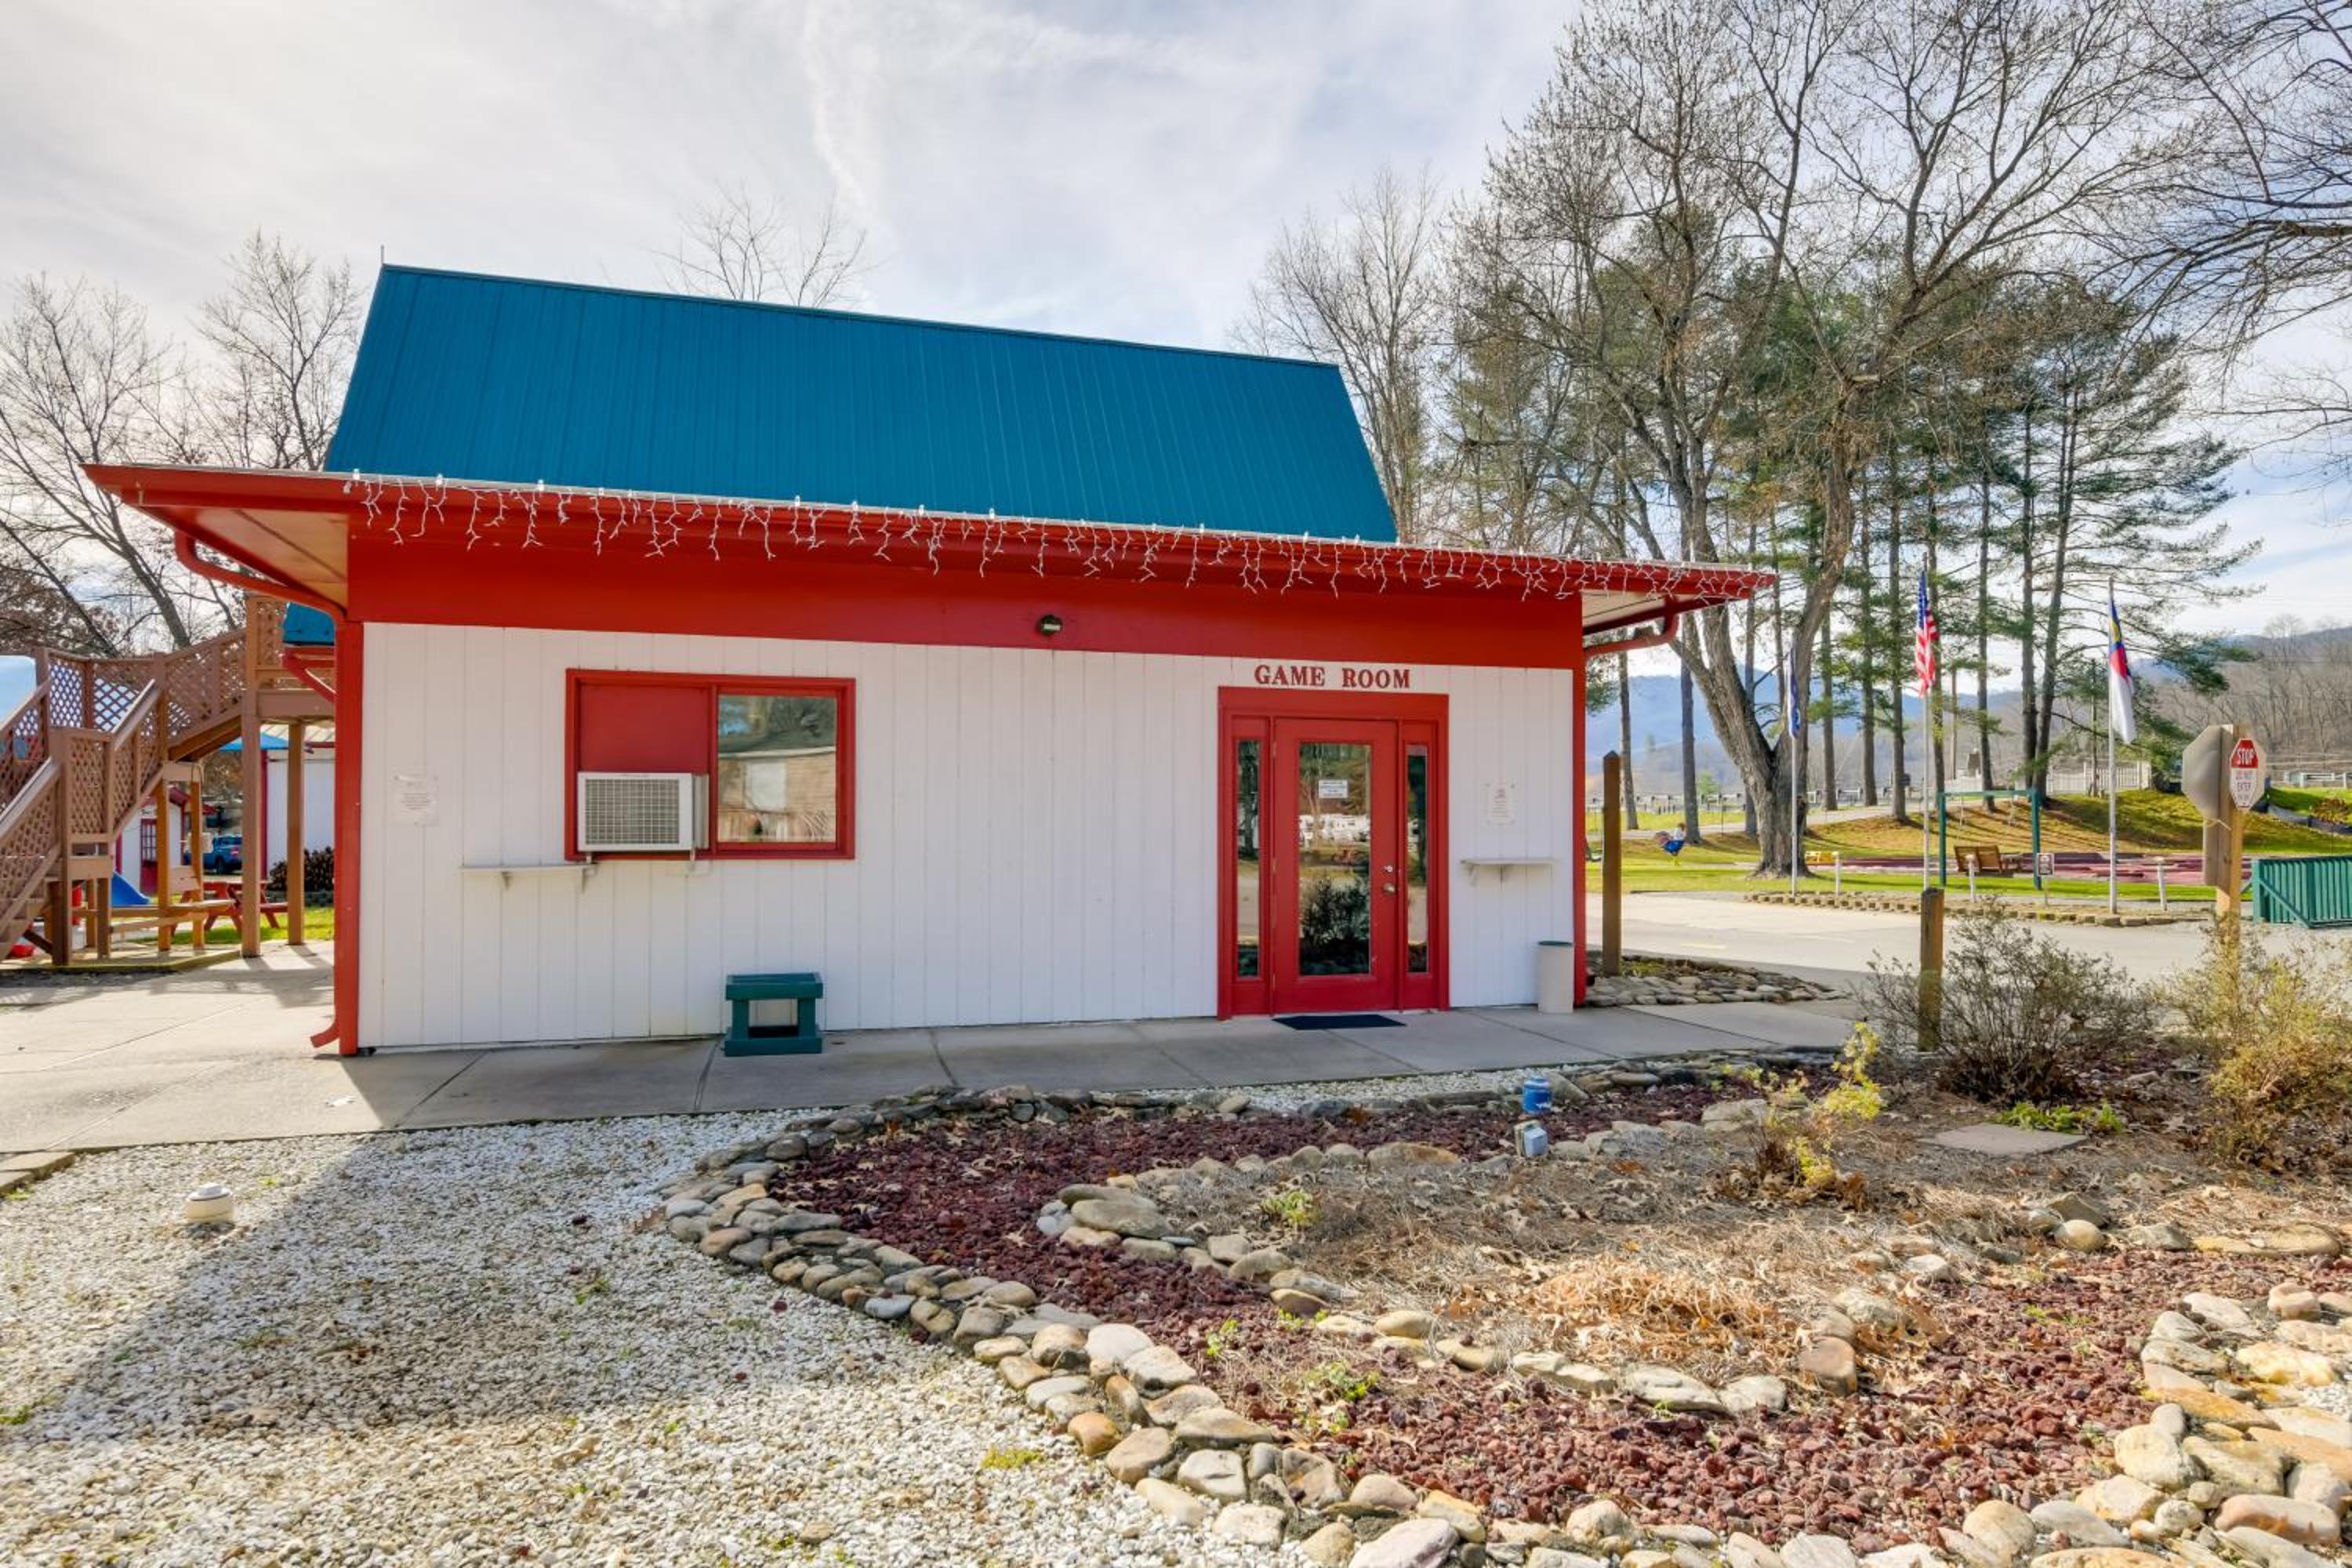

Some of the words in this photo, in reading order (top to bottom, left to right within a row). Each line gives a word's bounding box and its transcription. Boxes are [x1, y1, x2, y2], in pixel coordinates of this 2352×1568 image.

[1254, 664, 1326, 687] GAME
[1341, 667, 1410, 689] ROOM
[2237, 748, 2255, 766] STOP
